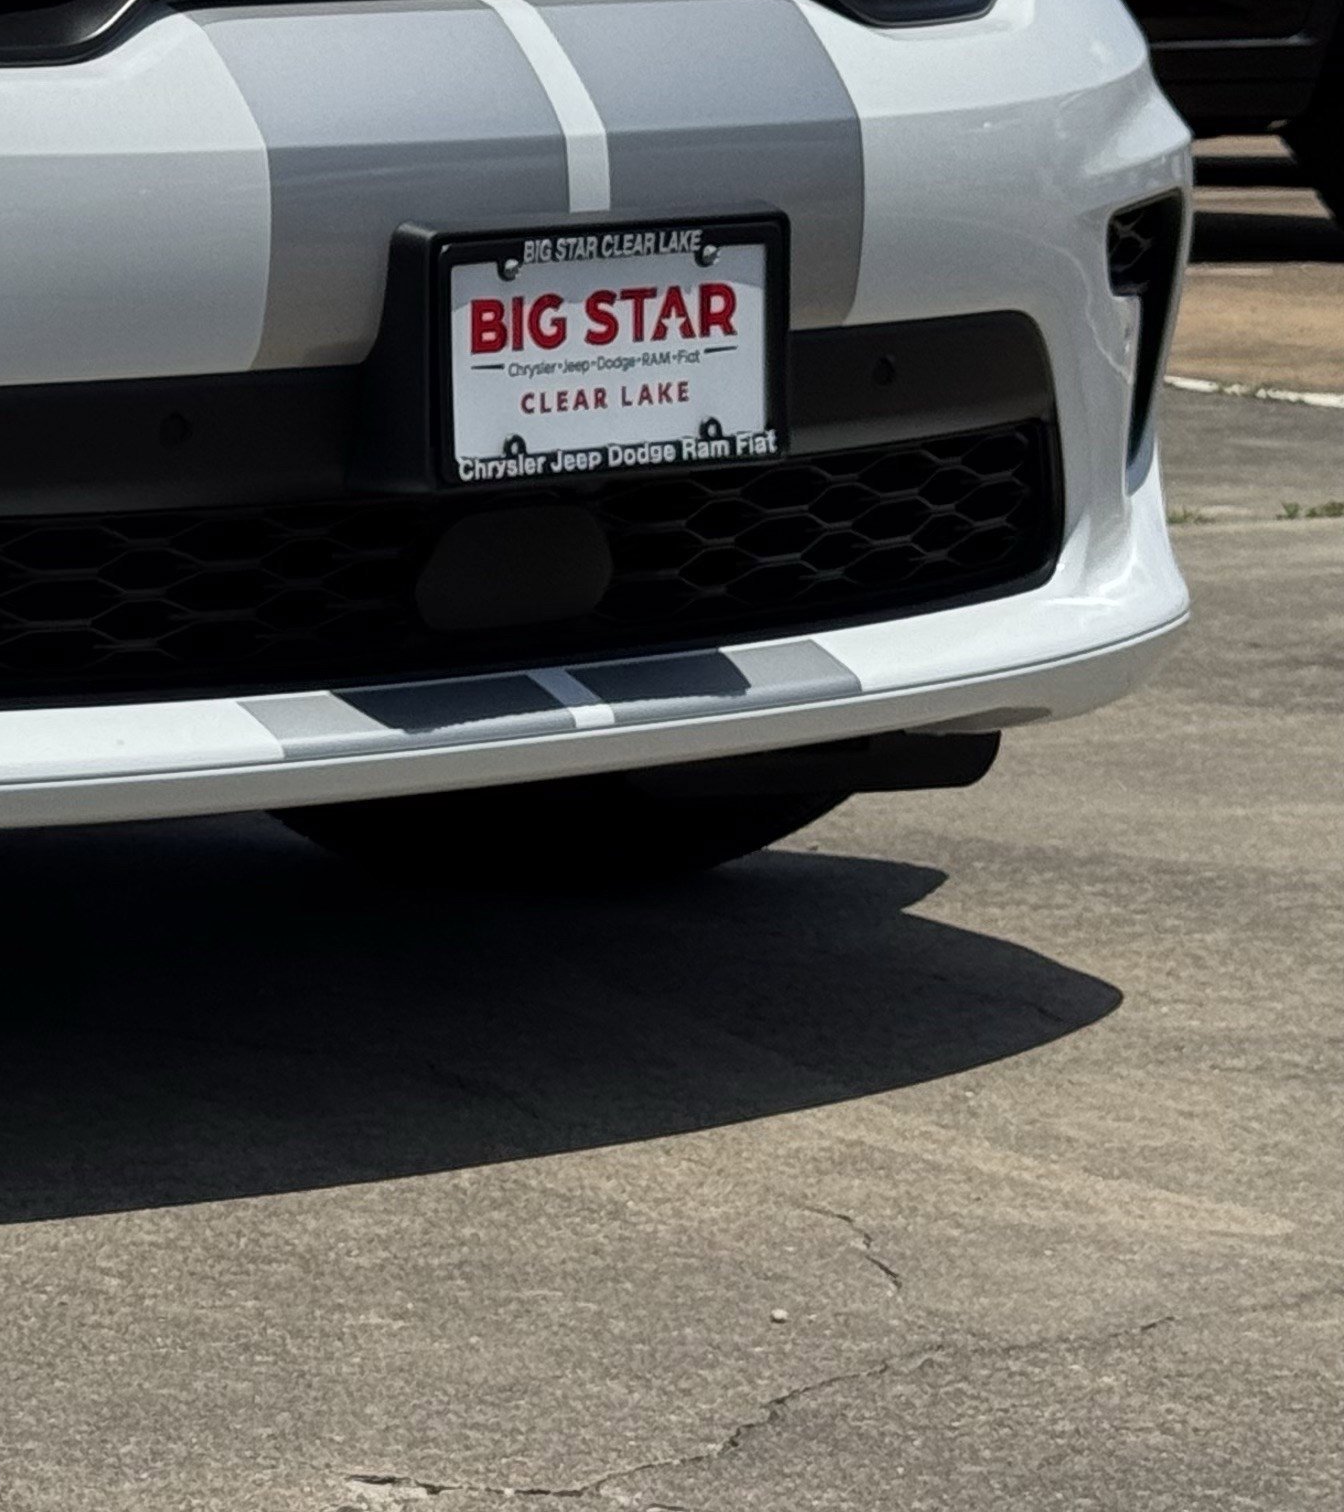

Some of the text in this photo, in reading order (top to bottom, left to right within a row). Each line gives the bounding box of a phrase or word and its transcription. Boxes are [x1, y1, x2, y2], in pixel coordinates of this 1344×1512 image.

[523, 229, 704, 263] BIG STAR CLEAR LAKE
[470, 280, 738, 355] BIG STAR
[508, 360, 557, 379] Chrysler
[562, 358, 590, 375] Jeep
[597, 355, 636, 372] Dodge
[642, 351, 671, 366] RAM
[520, 381, 690, 414] CLEAR LAKE
[458, 430, 778, 481] Chrysler Jeep Dodge Ram Fiat
